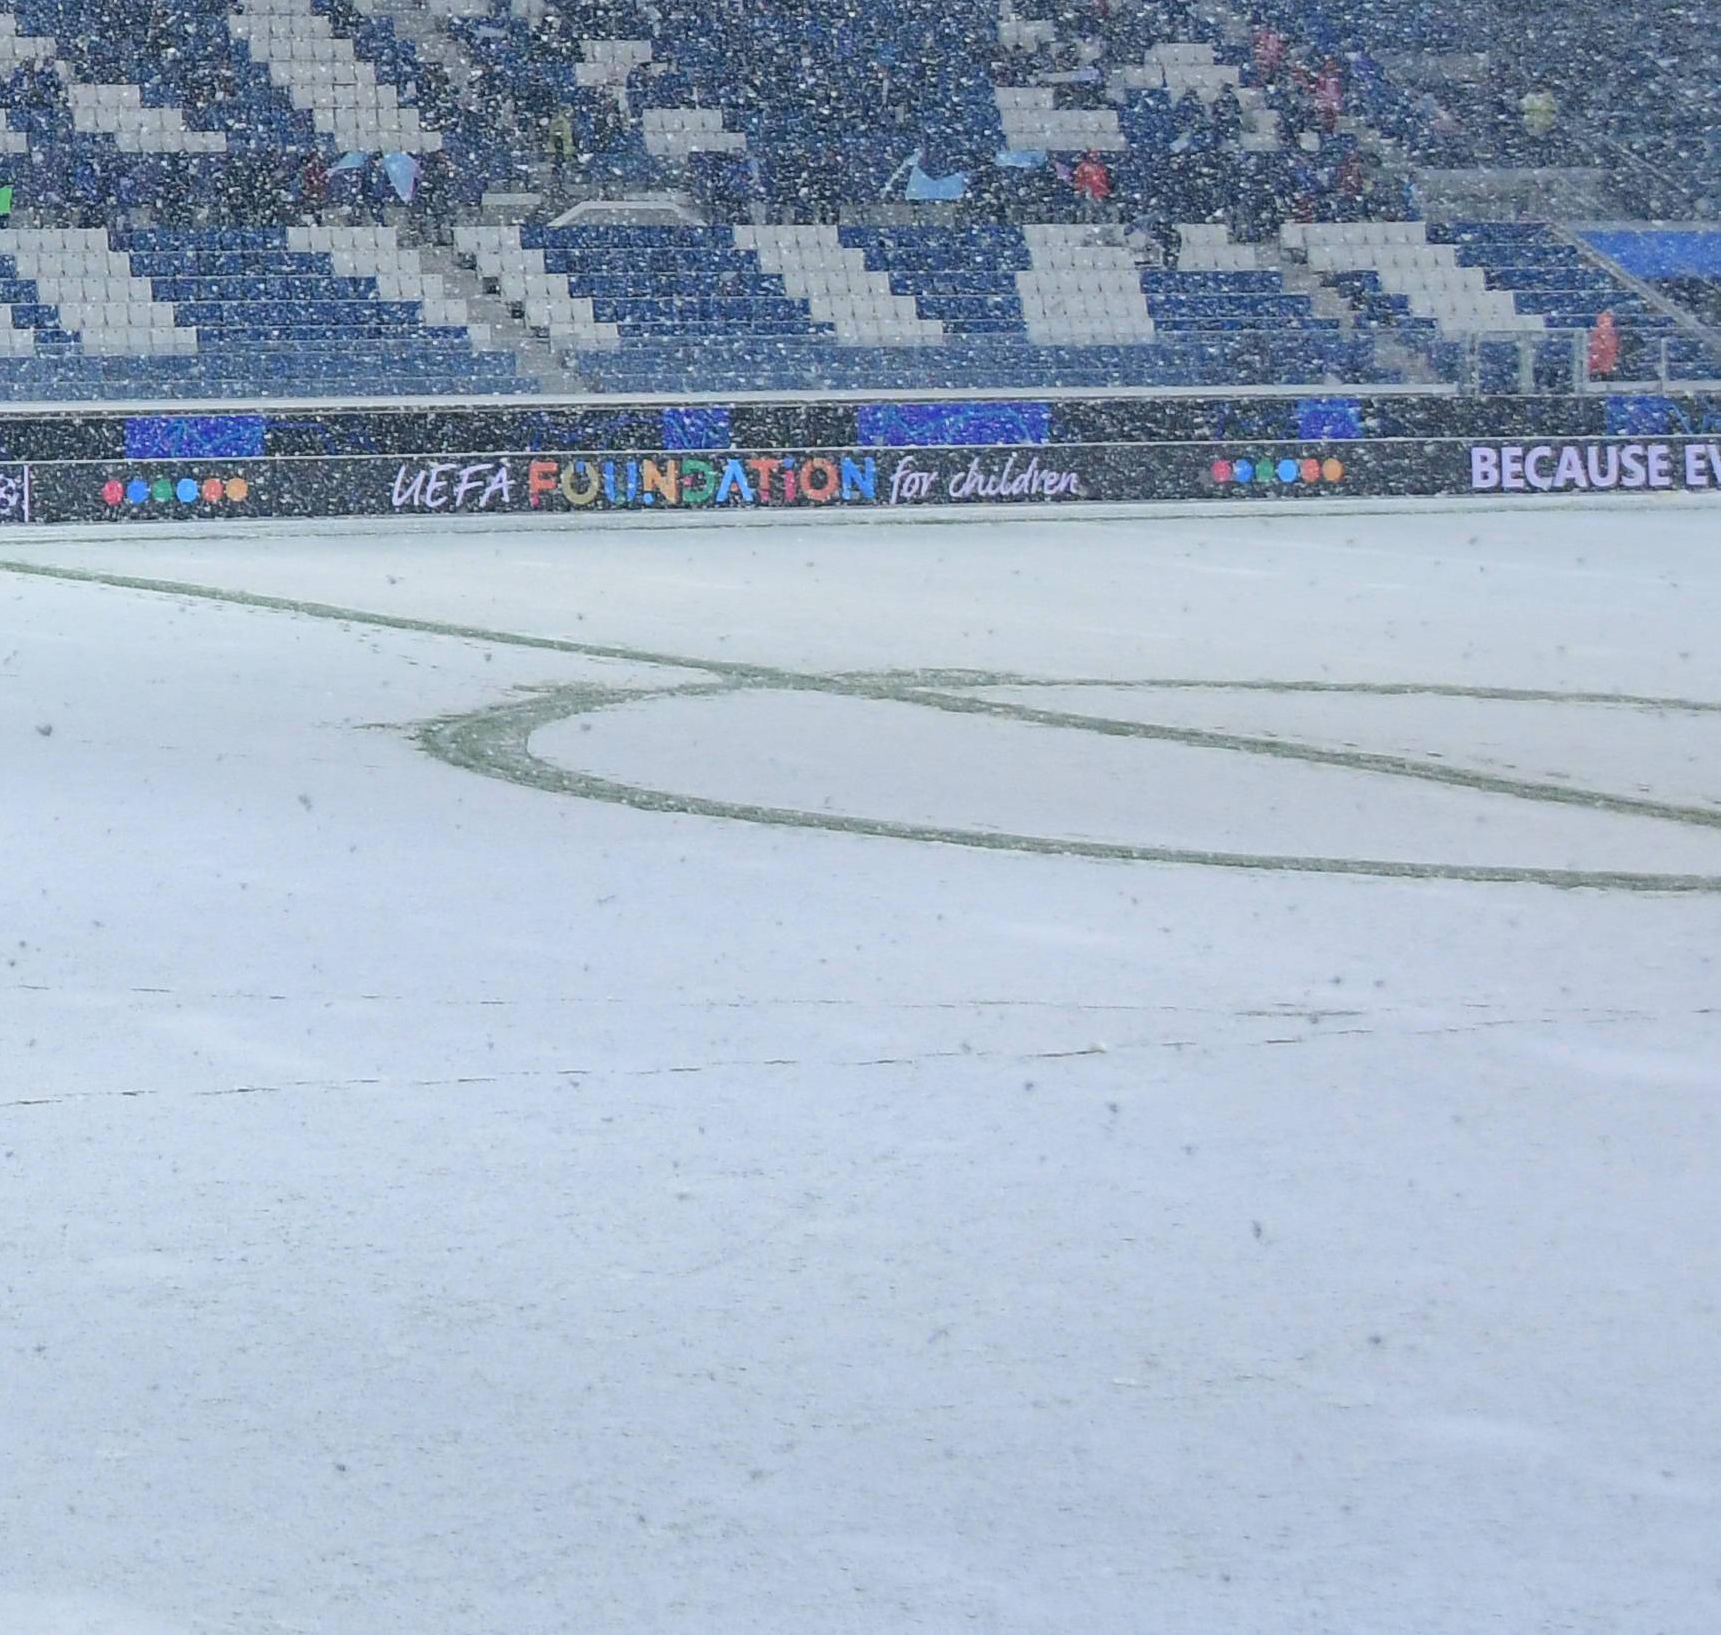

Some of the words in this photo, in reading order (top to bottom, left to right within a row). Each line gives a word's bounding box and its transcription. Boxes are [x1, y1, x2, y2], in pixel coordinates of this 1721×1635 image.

[391, 462, 510, 507] UEFA
[528, 455, 876, 507] FOUNDATION
[890, 456, 939, 504] for
[949, 456, 1081, 498] children
[1470, 445, 1673, 490] BECAUSE
